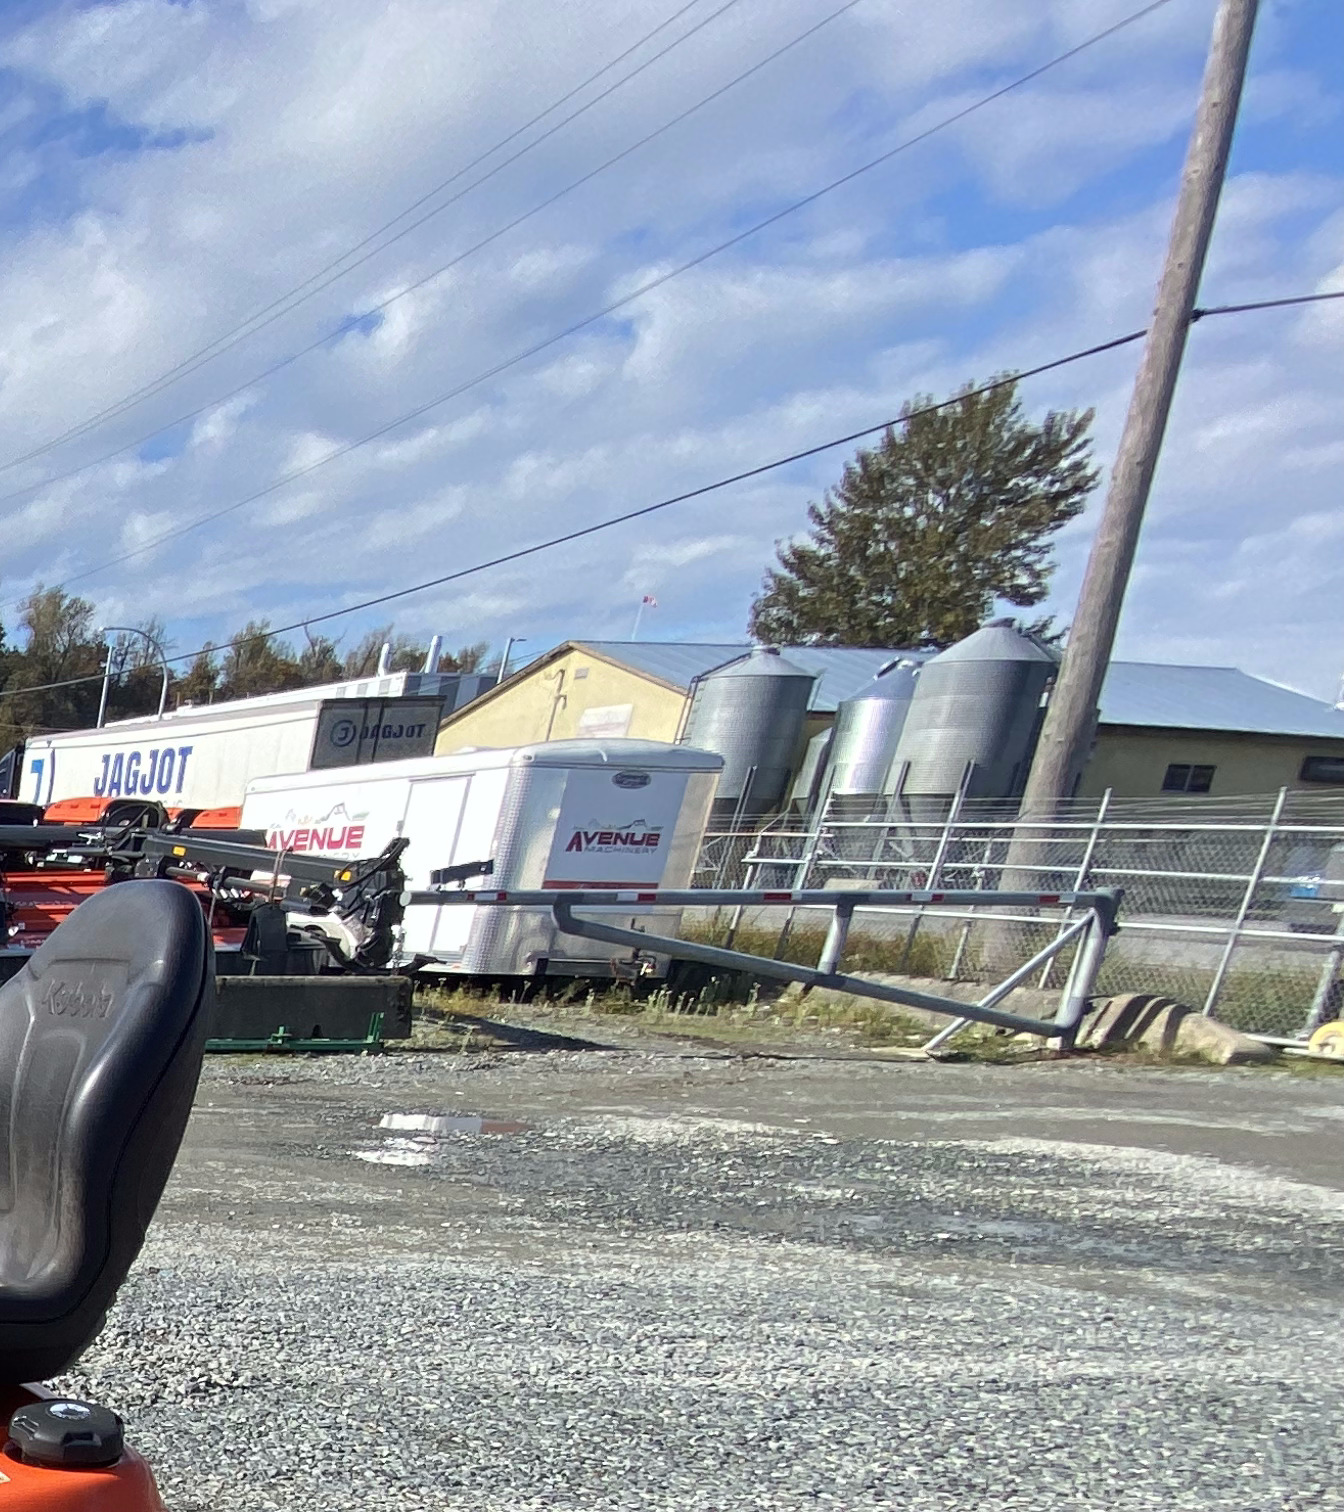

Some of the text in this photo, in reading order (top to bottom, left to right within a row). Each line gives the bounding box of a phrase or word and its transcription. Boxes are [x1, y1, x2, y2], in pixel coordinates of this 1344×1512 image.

[360, 723, 426, 740] JAGJOT
[93, 746, 193, 797] JAGJOT
[565, 831, 661, 852] AVENUE
